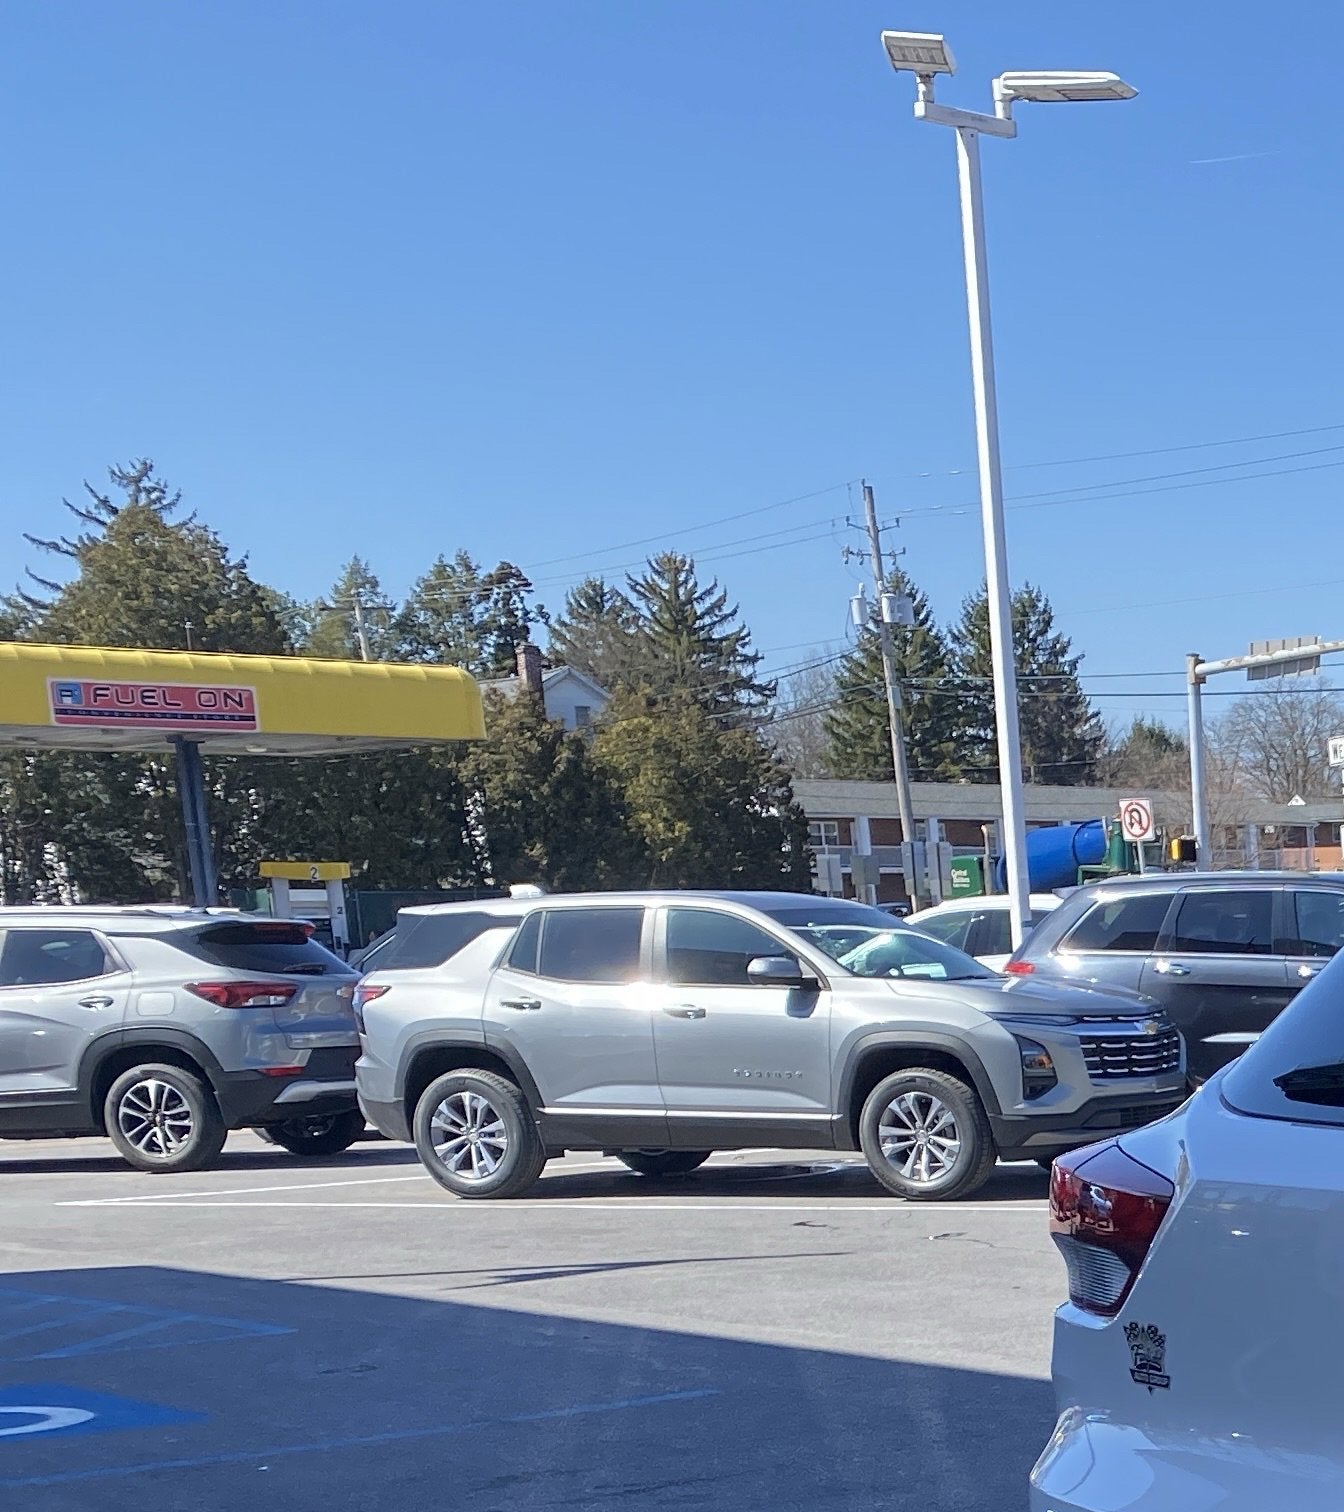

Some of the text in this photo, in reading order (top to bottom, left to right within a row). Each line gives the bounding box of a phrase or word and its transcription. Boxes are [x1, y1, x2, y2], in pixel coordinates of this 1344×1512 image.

[92, 685, 246, 710] FUEL ON
[310, 866, 318, 880] 2
[336, 906, 344, 915] 2
